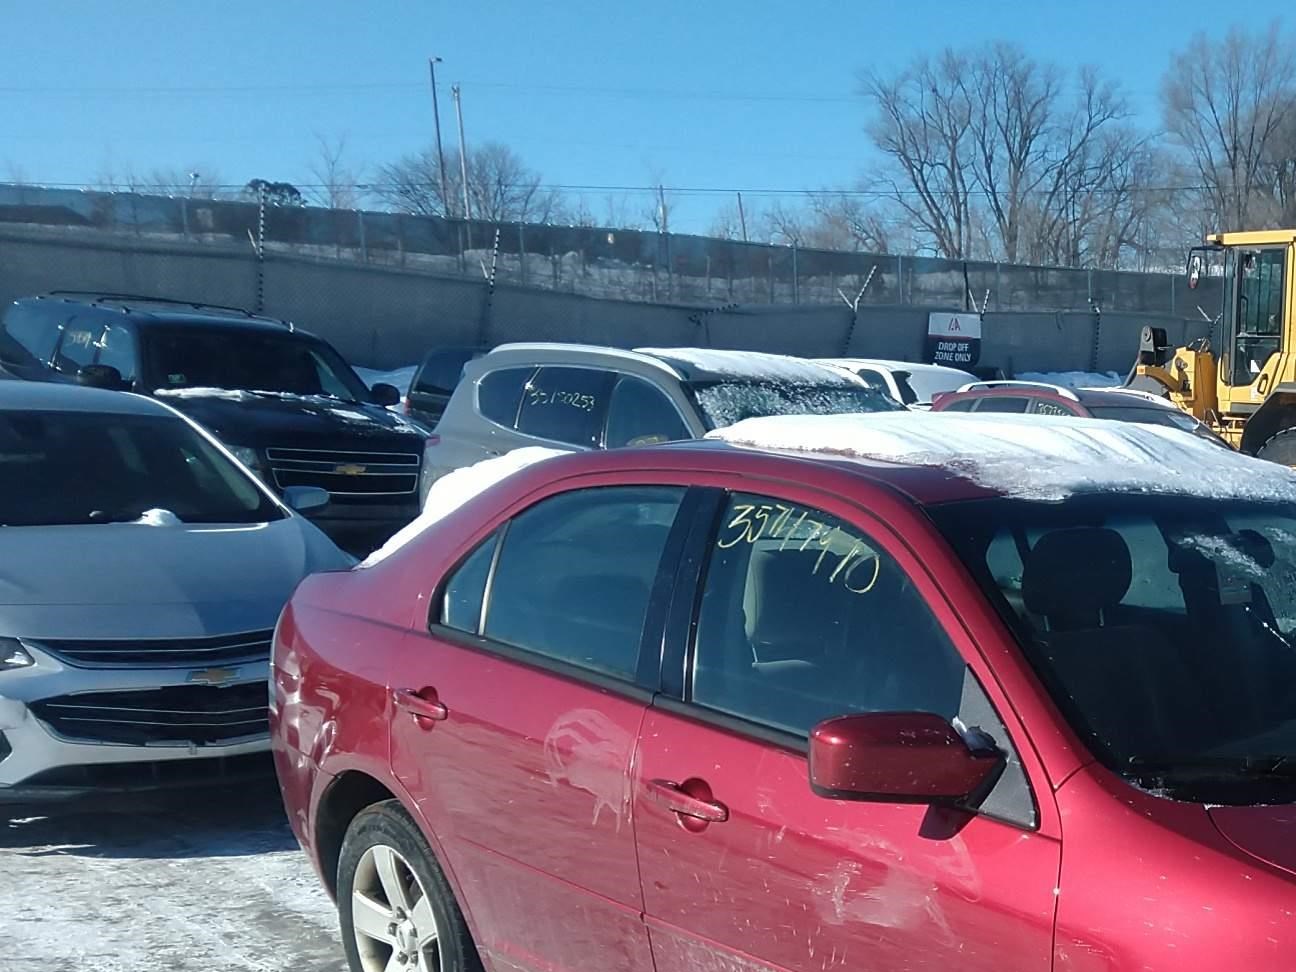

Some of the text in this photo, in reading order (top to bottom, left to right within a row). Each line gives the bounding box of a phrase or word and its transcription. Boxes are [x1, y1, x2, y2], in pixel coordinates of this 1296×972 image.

[938, 342, 969, 351] DROP OFF
[934, 352, 971, 362] ZONE ONLY
